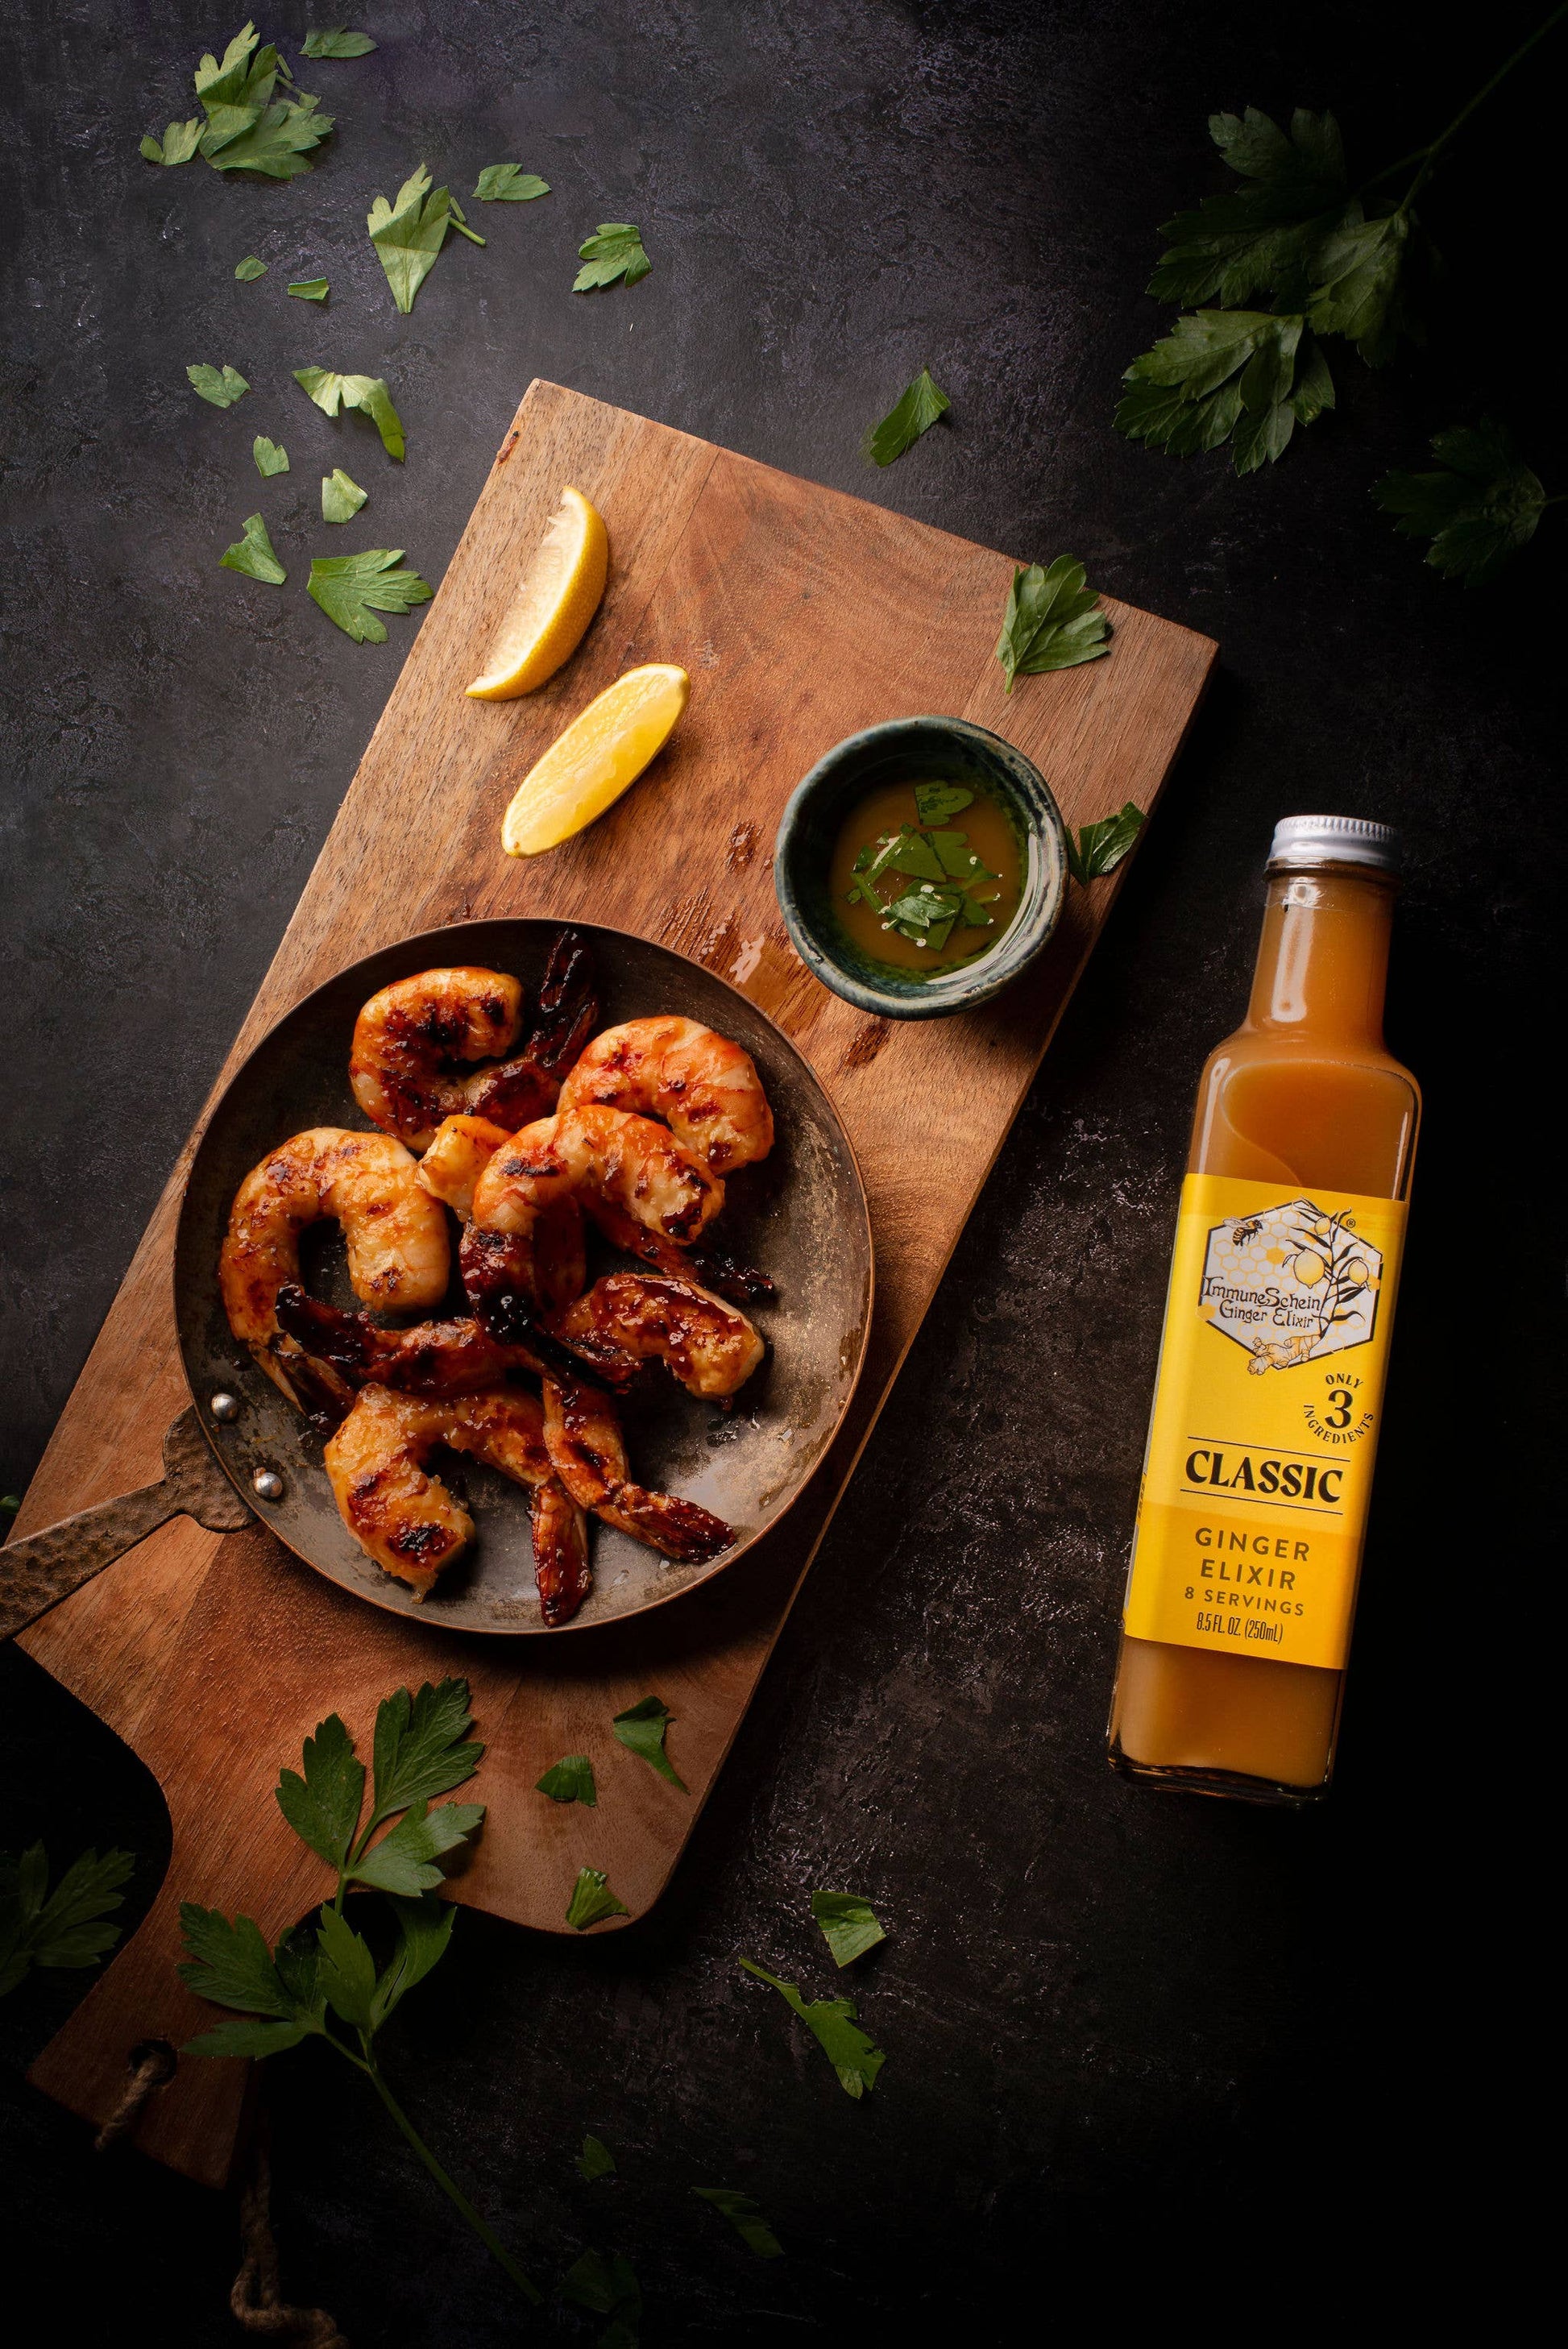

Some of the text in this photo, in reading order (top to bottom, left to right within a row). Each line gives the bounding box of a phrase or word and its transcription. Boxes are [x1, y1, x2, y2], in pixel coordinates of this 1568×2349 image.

[1203, 1276, 1321, 1310] ImmuneSchein
[1219, 1299, 1313, 1328] Ginger Elixir
[1325, 1373, 1363, 1388] ONLY
[1303, 1405, 1374, 1444] INGREDIENTS
[1325, 1389, 1354, 1429] 3
[1185, 1450, 1343, 1504] CLASSIC
[1195, 1527, 1309, 1562] GINGER
[1201, 1558, 1296, 1590] ELIXIR
[1184, 1586, 1304, 1616] 8 SERVINGS
[1197, 1612, 1284, 1645] 8.5 FL. OZ. (250mL)
